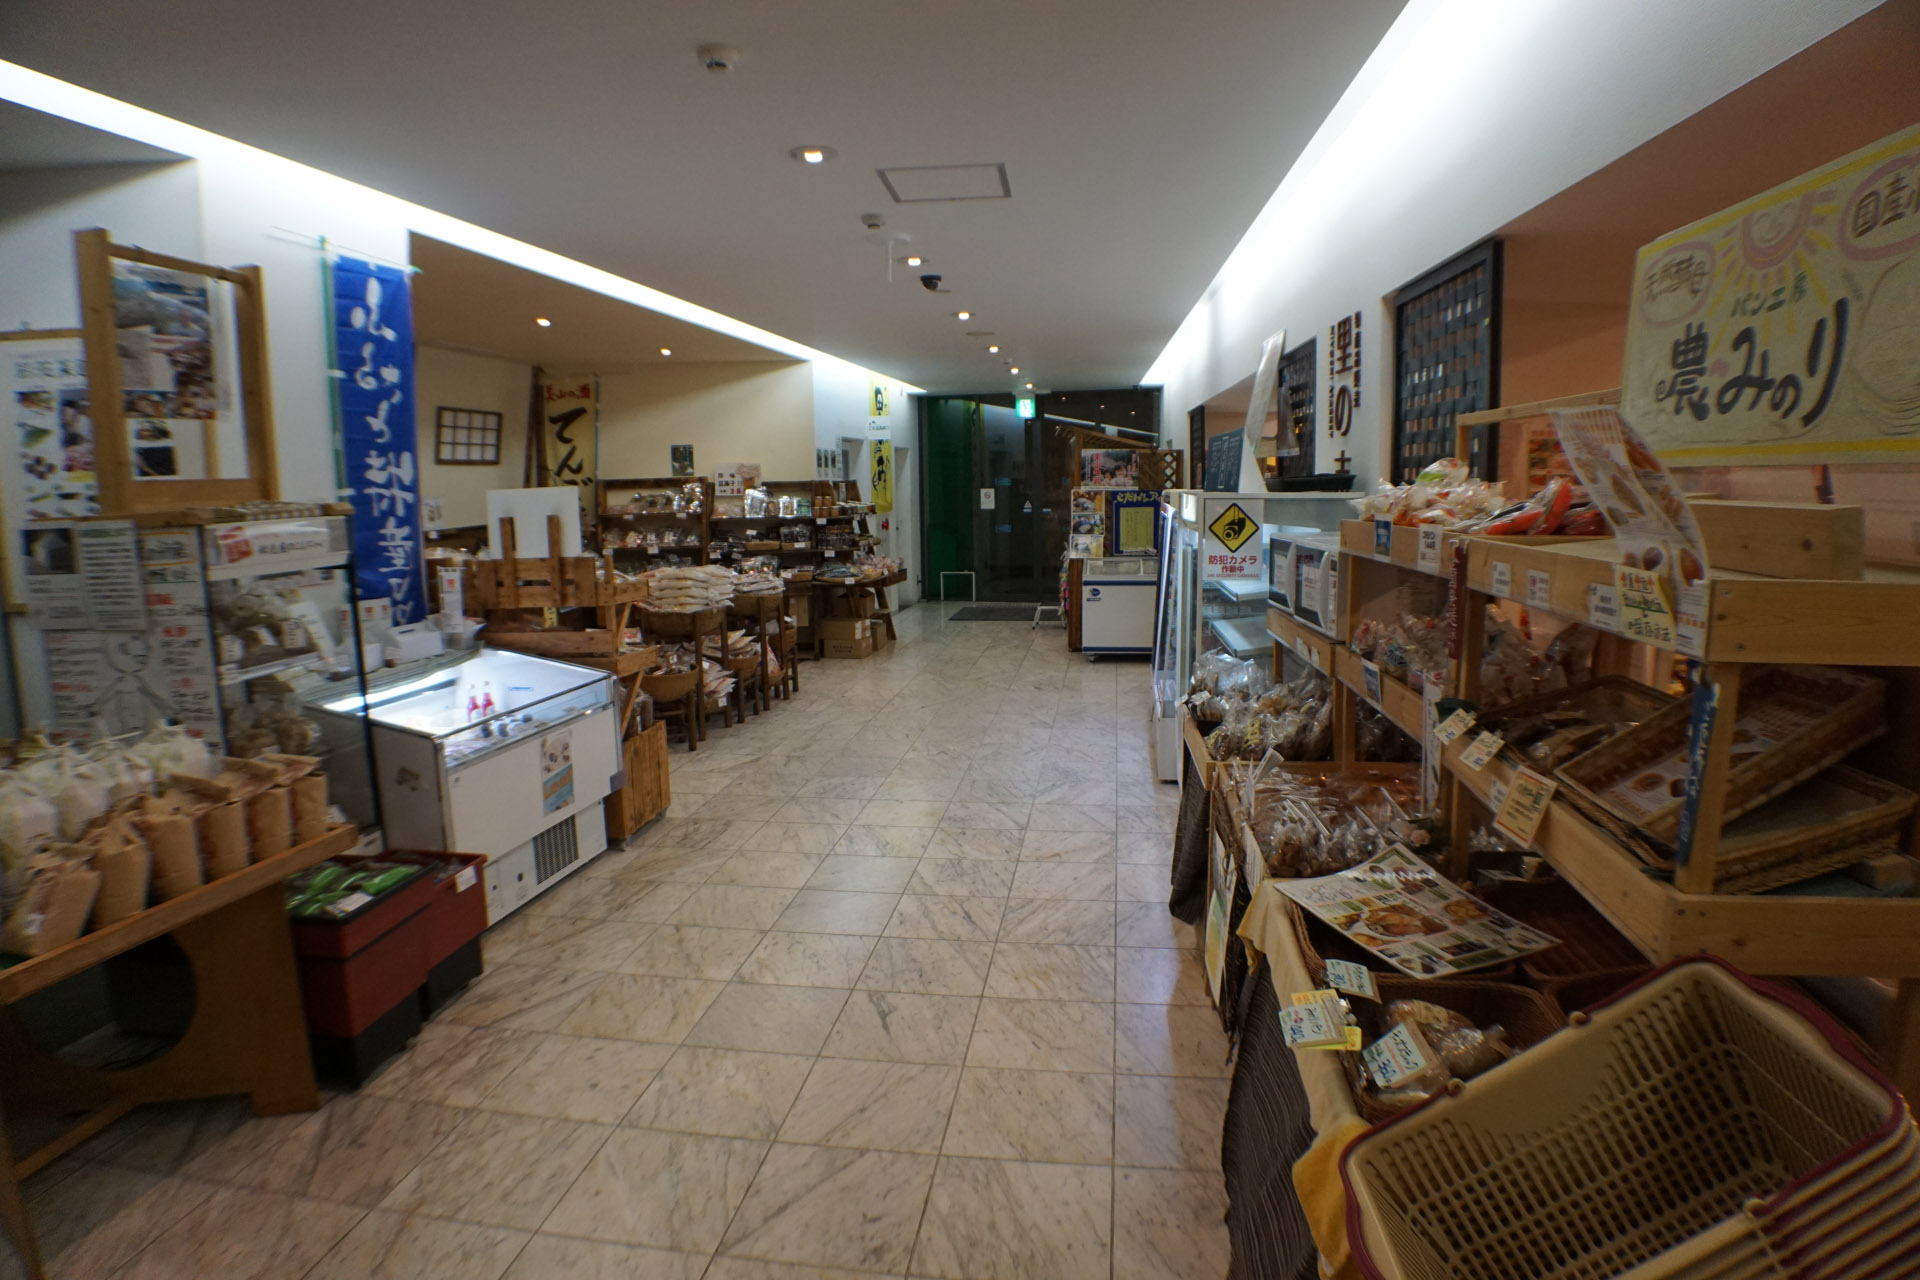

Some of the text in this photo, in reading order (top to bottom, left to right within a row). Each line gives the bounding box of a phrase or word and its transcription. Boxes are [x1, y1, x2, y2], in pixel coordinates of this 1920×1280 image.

[1208, 554, 1257, 565] 防犯カメラ
[1221, 565, 1245, 573] 作動中
